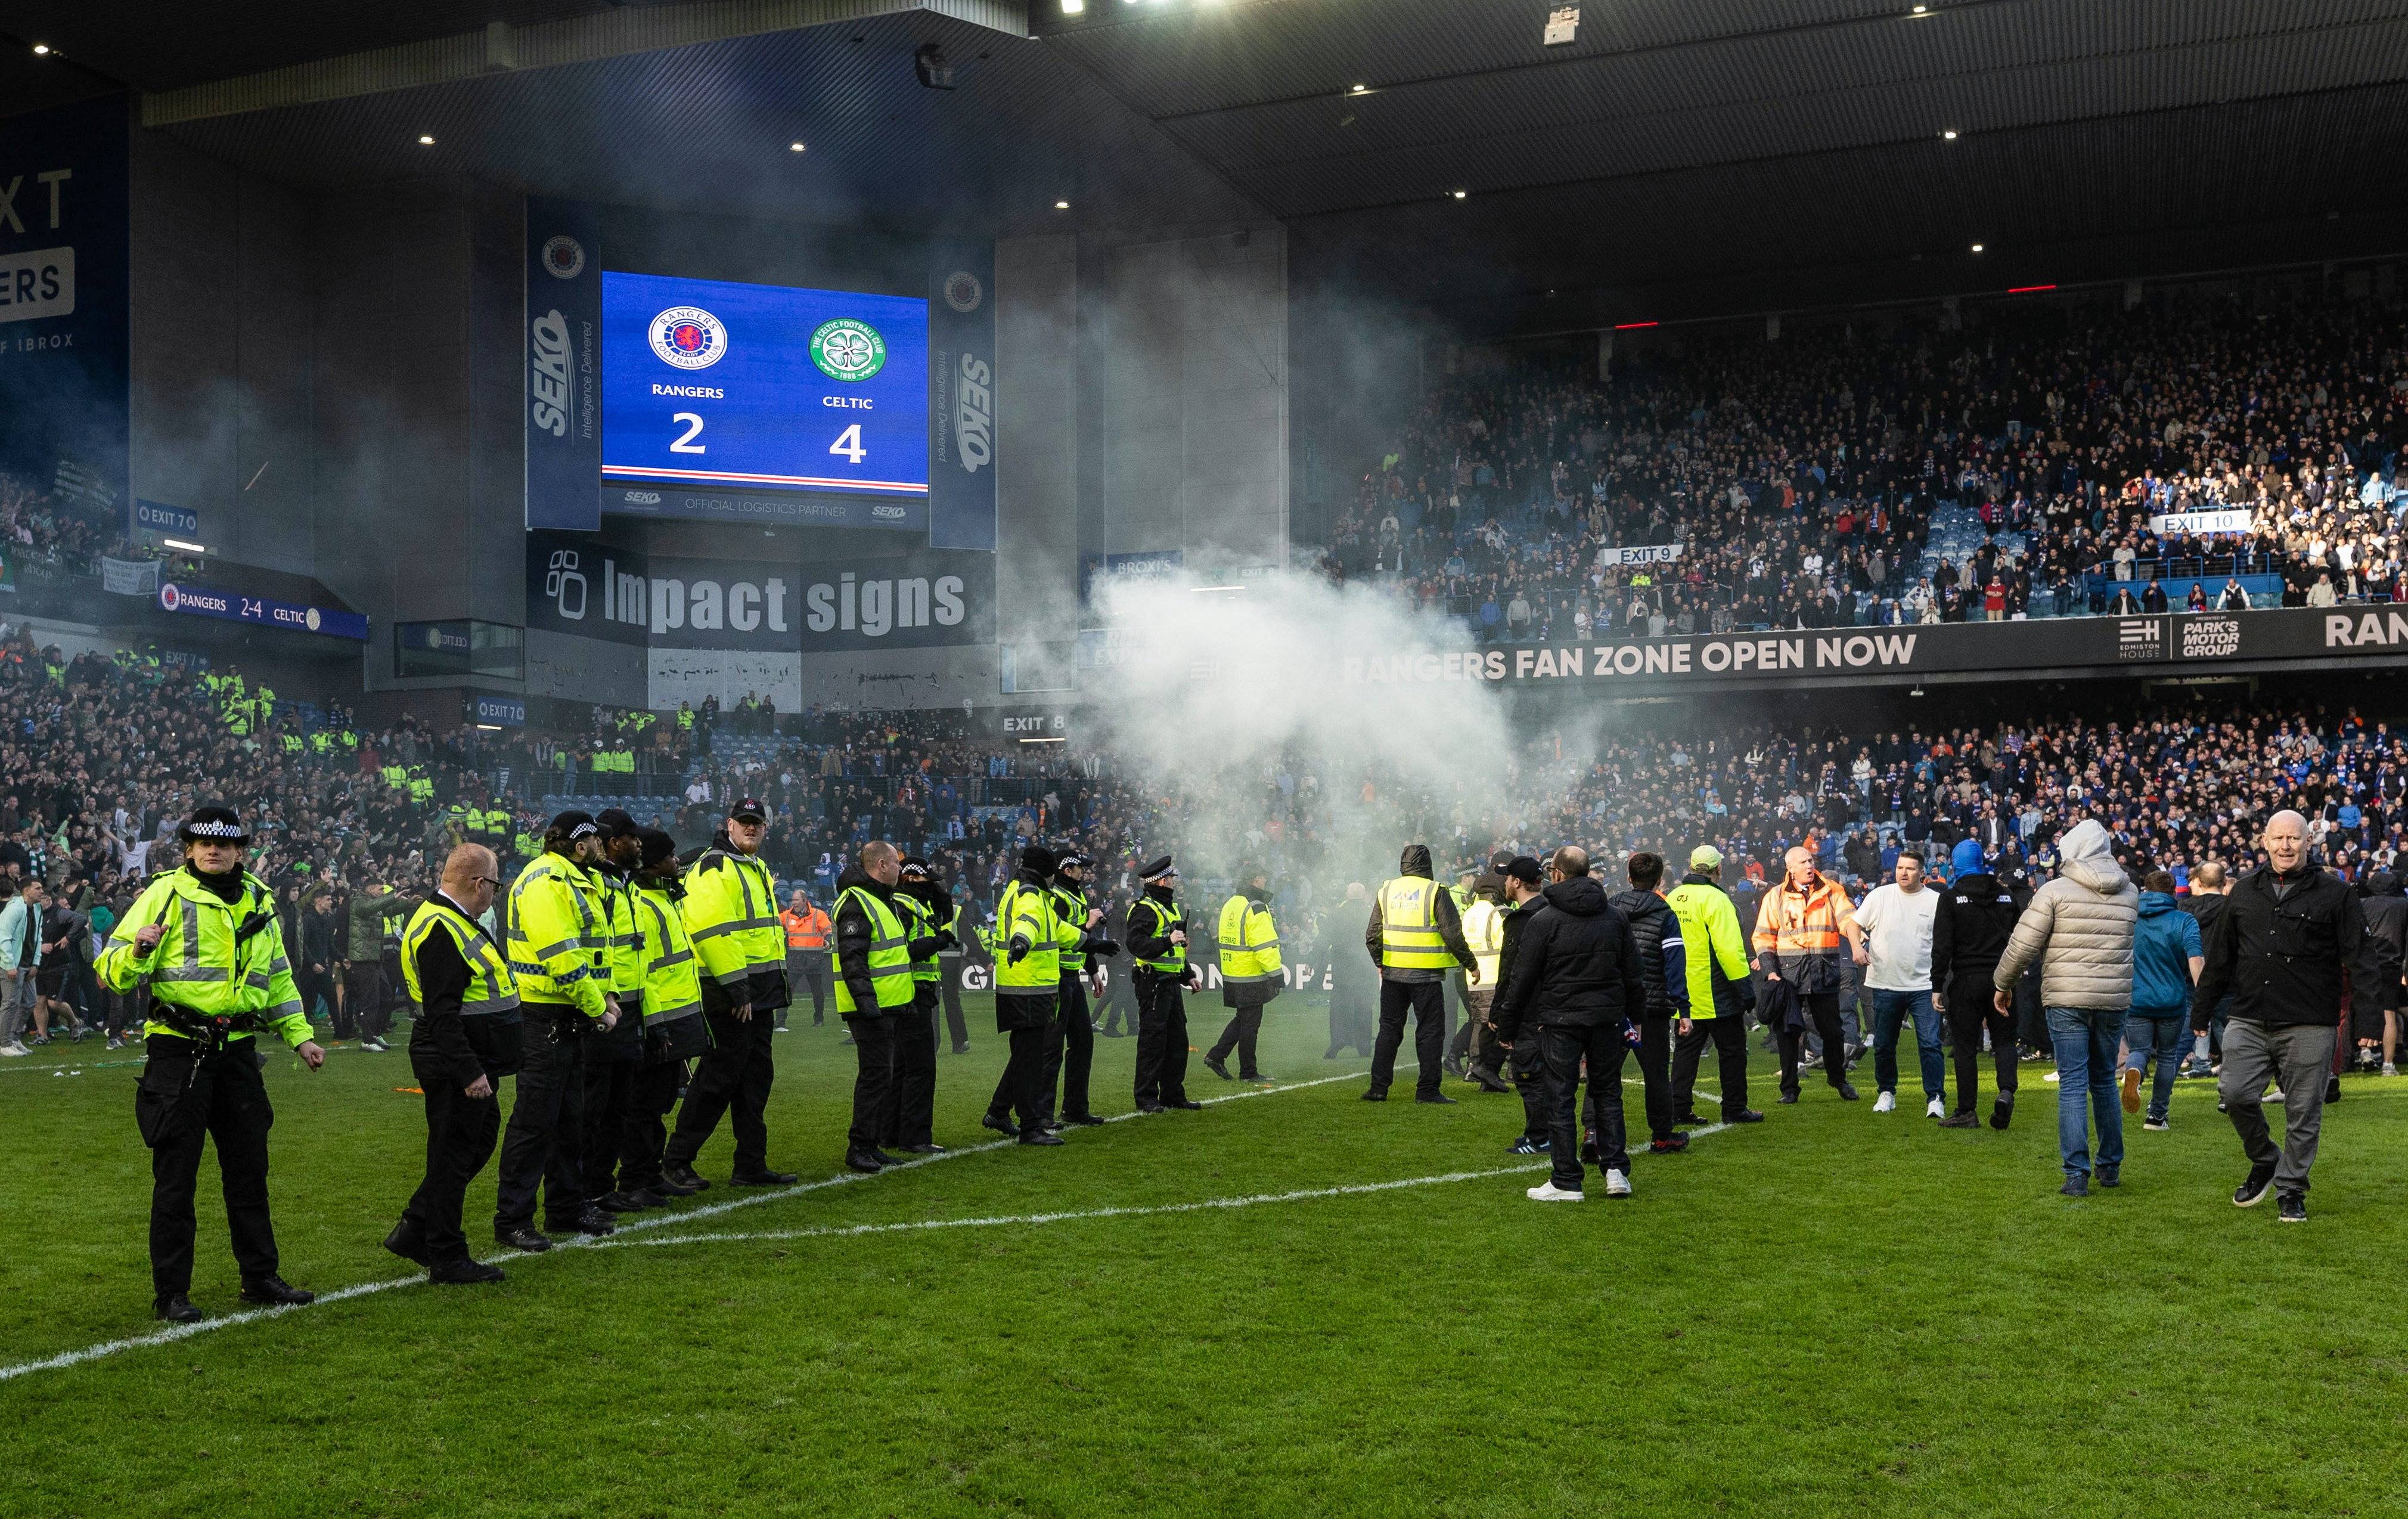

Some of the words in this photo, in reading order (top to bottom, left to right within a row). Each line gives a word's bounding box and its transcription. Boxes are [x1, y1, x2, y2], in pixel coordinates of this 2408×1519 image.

[660, 311, 717, 329] RANGERS
[18, 333, 73, 352] IBROX
[813, 336, 822, 349] THE
[818, 322, 839, 336] CELTIC
[839, 321, 874, 338] FOOTBALL
[872, 337, 883, 354] CLUB
[582, 322, 592, 375] Delivered
[656, 341, 702, 365] FOOTBALL
[703, 345, 721, 362] CLUB
[533, 309, 566, 437] SEKO
[938, 351, 948, 410] Intelligence
[652, 383, 724, 399] RANGERS
[582, 377, 592, 439] Intelligence
[823, 396, 873, 410] CELTIC
[961, 352, 991, 473] SEKO
[669, 412, 706, 454] 2
[938, 413, 948, 462] Delivered
[829, 423, 867, 464] 4
[625, 491, 661, 504] SEKO
[685, 498, 736, 512] OFFICIAL
[738, 501, 796, 514] LOGISTICS
[799, 505, 847, 517] PARTNER
[871, 506, 907, 519] SEKO
[152, 509, 175, 525] EXIT
[179, 515, 185, 527] 7
[2165, 517, 2206, 531] EXIT
[2214, 515, 2233, 528] 10
[1621, 548, 1657, 562] EXIT
[1661, 547, 1670, 560] 9
[1118, 560, 1172, 575] BROXI'S
[604, 559, 787, 634] Impact
[807, 572, 965, 636] signs
[181, 594, 226, 612] RANGERS
[241, 598, 262, 618] 2-4
[274, 608, 305, 623] CELTIC
[2183, 621, 2239, 634] PARK'S
[2326, 612, 2408, 647] RAN
[2183, 633, 2240, 646] MOTOR
[1516, 648, 1583, 678] FAN
[1594, 643, 1692, 675] ZONE
[1701, 638, 1804, 672] OPEN
[1816, 634, 1917, 668] NOW
[2120, 649, 2159, 659] HOUSE
[2183, 644, 2238, 656] GROUP
[489, 704, 507, 717] EXIT
[510, 706, 515, 718] 7
[1004, 717, 1044, 731] EXIT
[1054, 715, 1065, 729] 8
[1221, 936, 1236, 944] STEWARD
[1222, 953, 1232, 962] 278
